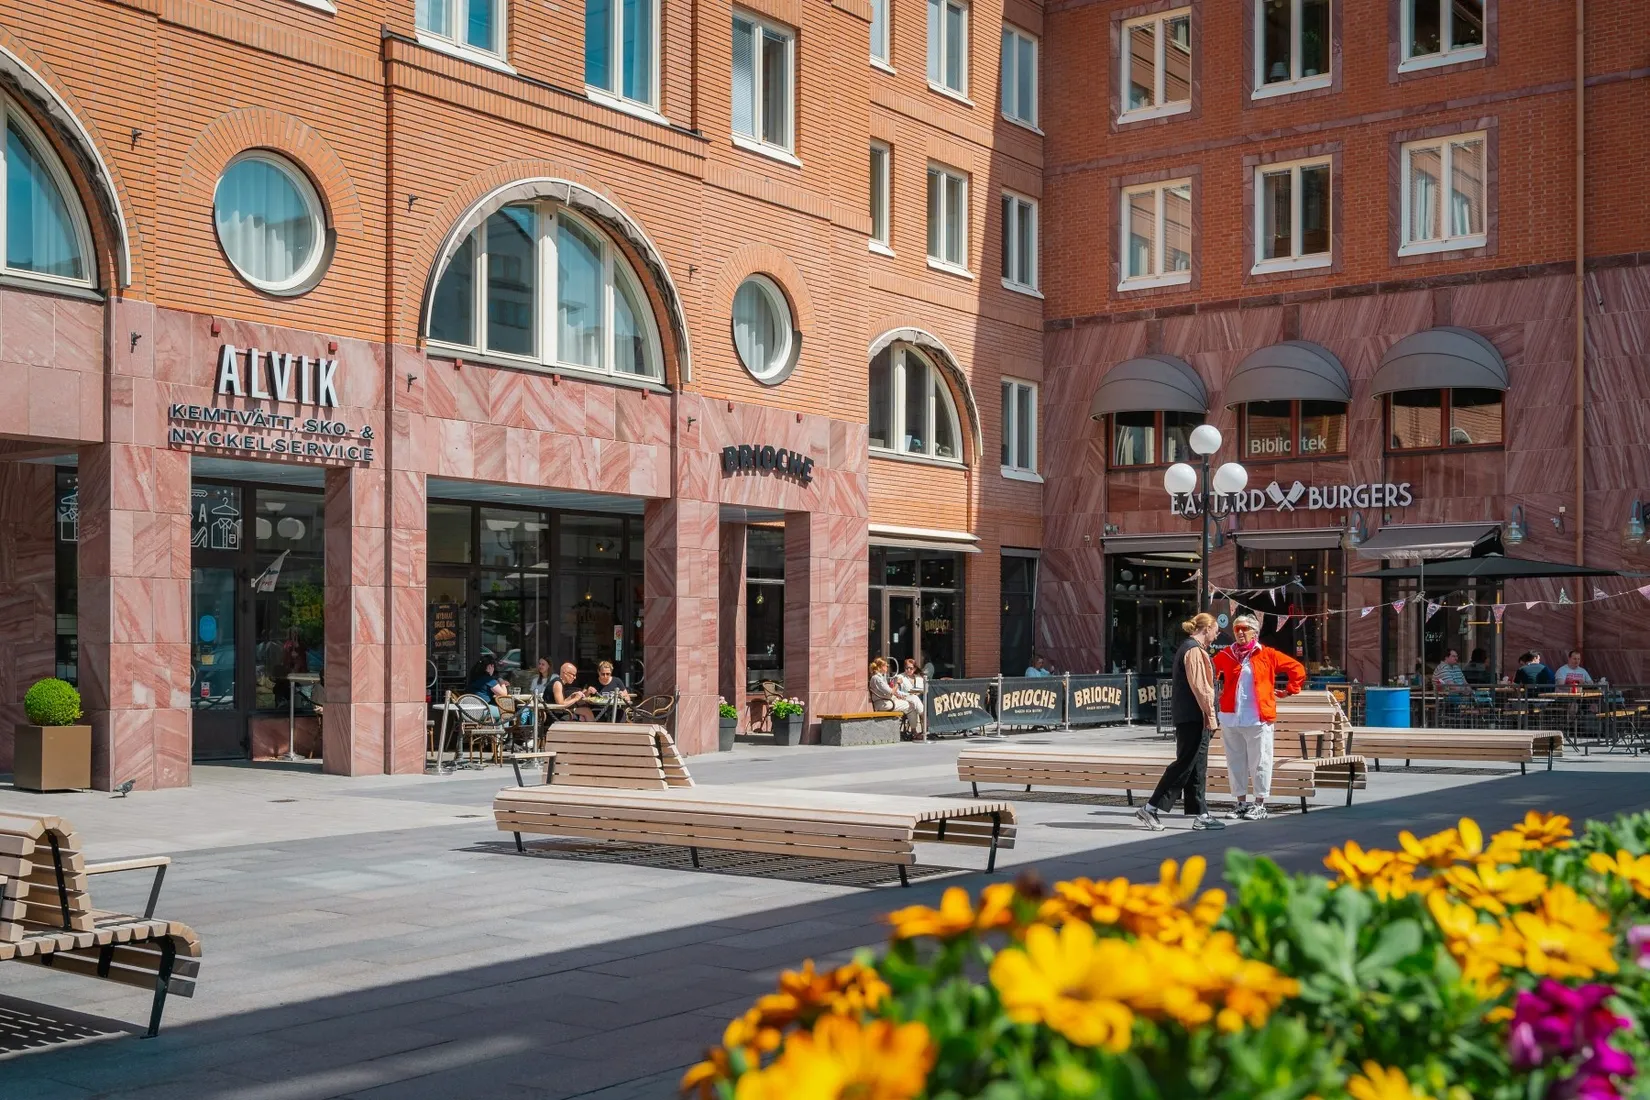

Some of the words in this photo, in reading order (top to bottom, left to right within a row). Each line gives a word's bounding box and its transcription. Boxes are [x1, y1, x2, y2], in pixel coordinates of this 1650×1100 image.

[218, 344, 339, 408] ALVIK
[305, 418, 355, 437] SKO-
[361, 425, 375, 440] &
[171, 428, 374, 462] NYCKELSERVICE
[722, 445, 815, 483] BRIOCHE
[1308, 482, 1413, 511] BURGERS
[933, 691, 981, 716] BRIOCHE
[1002, 689, 1057, 711] BRIOCHE
[1074, 686, 1122, 708] BRIOCHE
